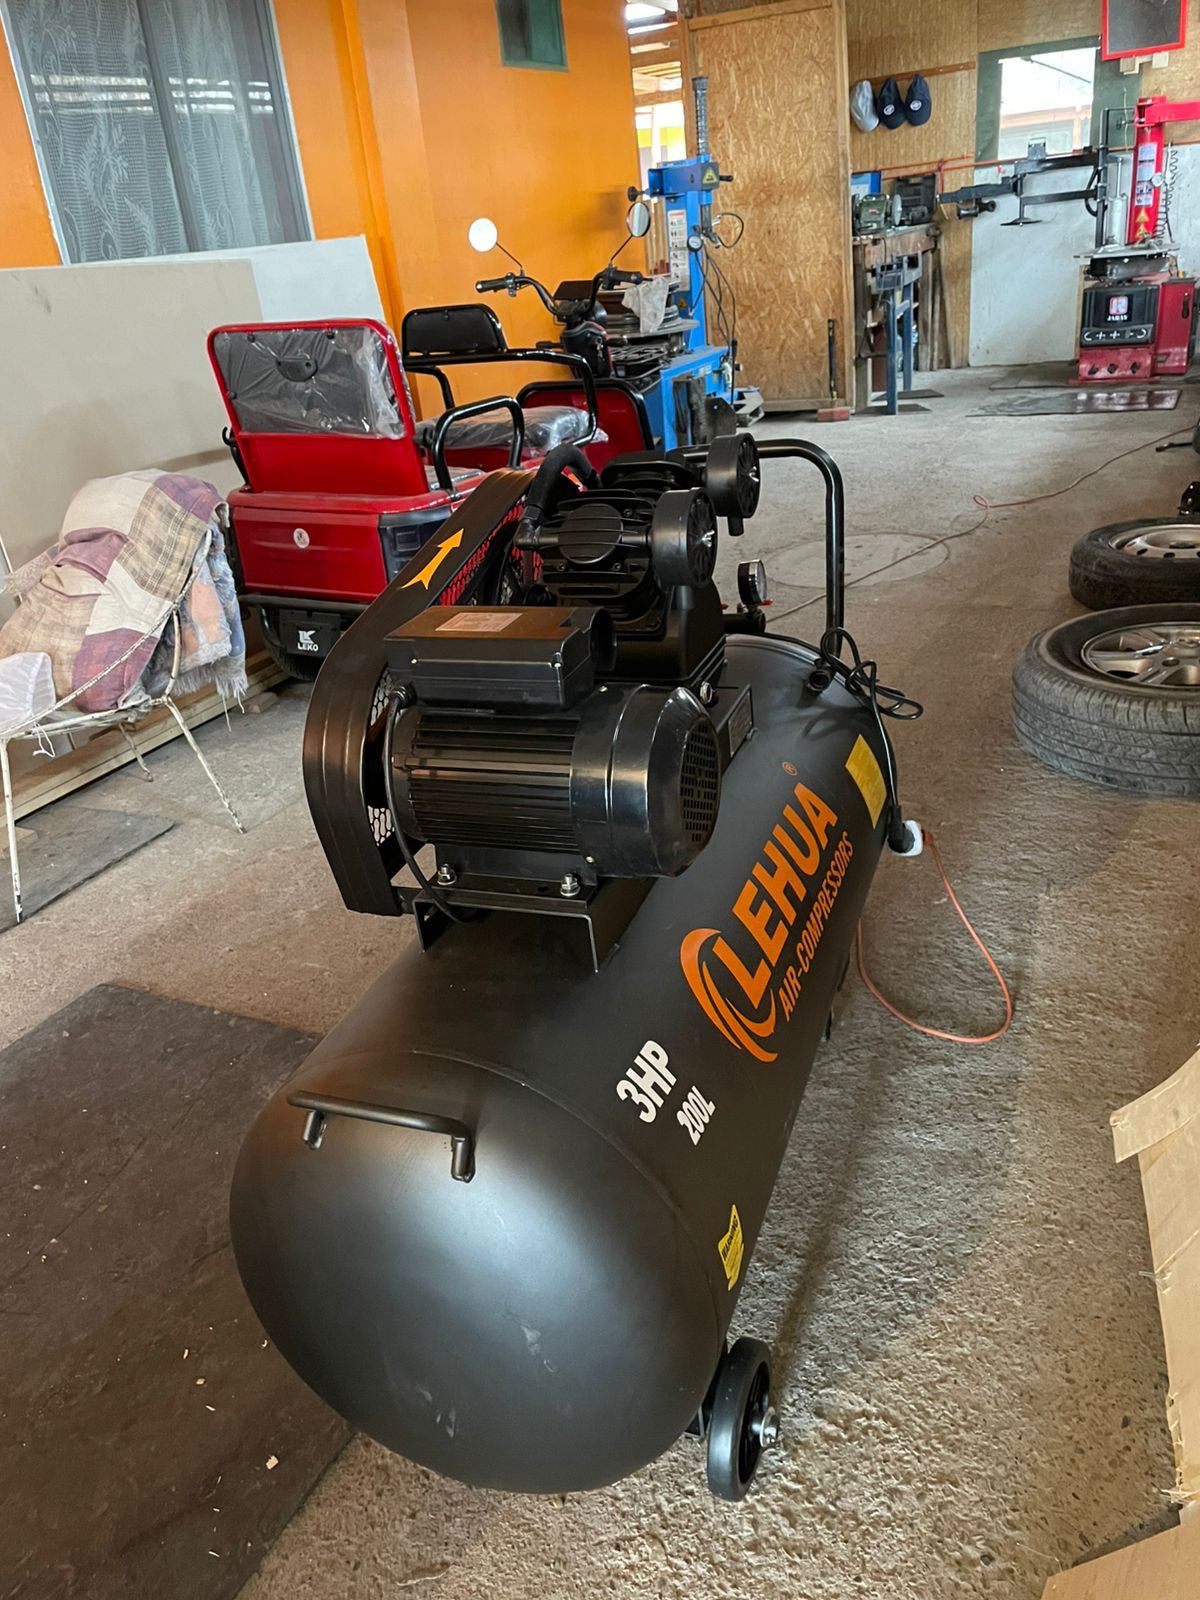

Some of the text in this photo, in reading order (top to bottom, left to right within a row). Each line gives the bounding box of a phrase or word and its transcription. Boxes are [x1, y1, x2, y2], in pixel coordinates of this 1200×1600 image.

[297, 642, 319, 652] LEKO
[712, 782, 838, 1009] LEHUA
[778, 831, 854, 1022] AIR-COMPRESSORS
[616, 1040, 677, 1123] 3HP
[676, 1085, 716, 1146] 200L
